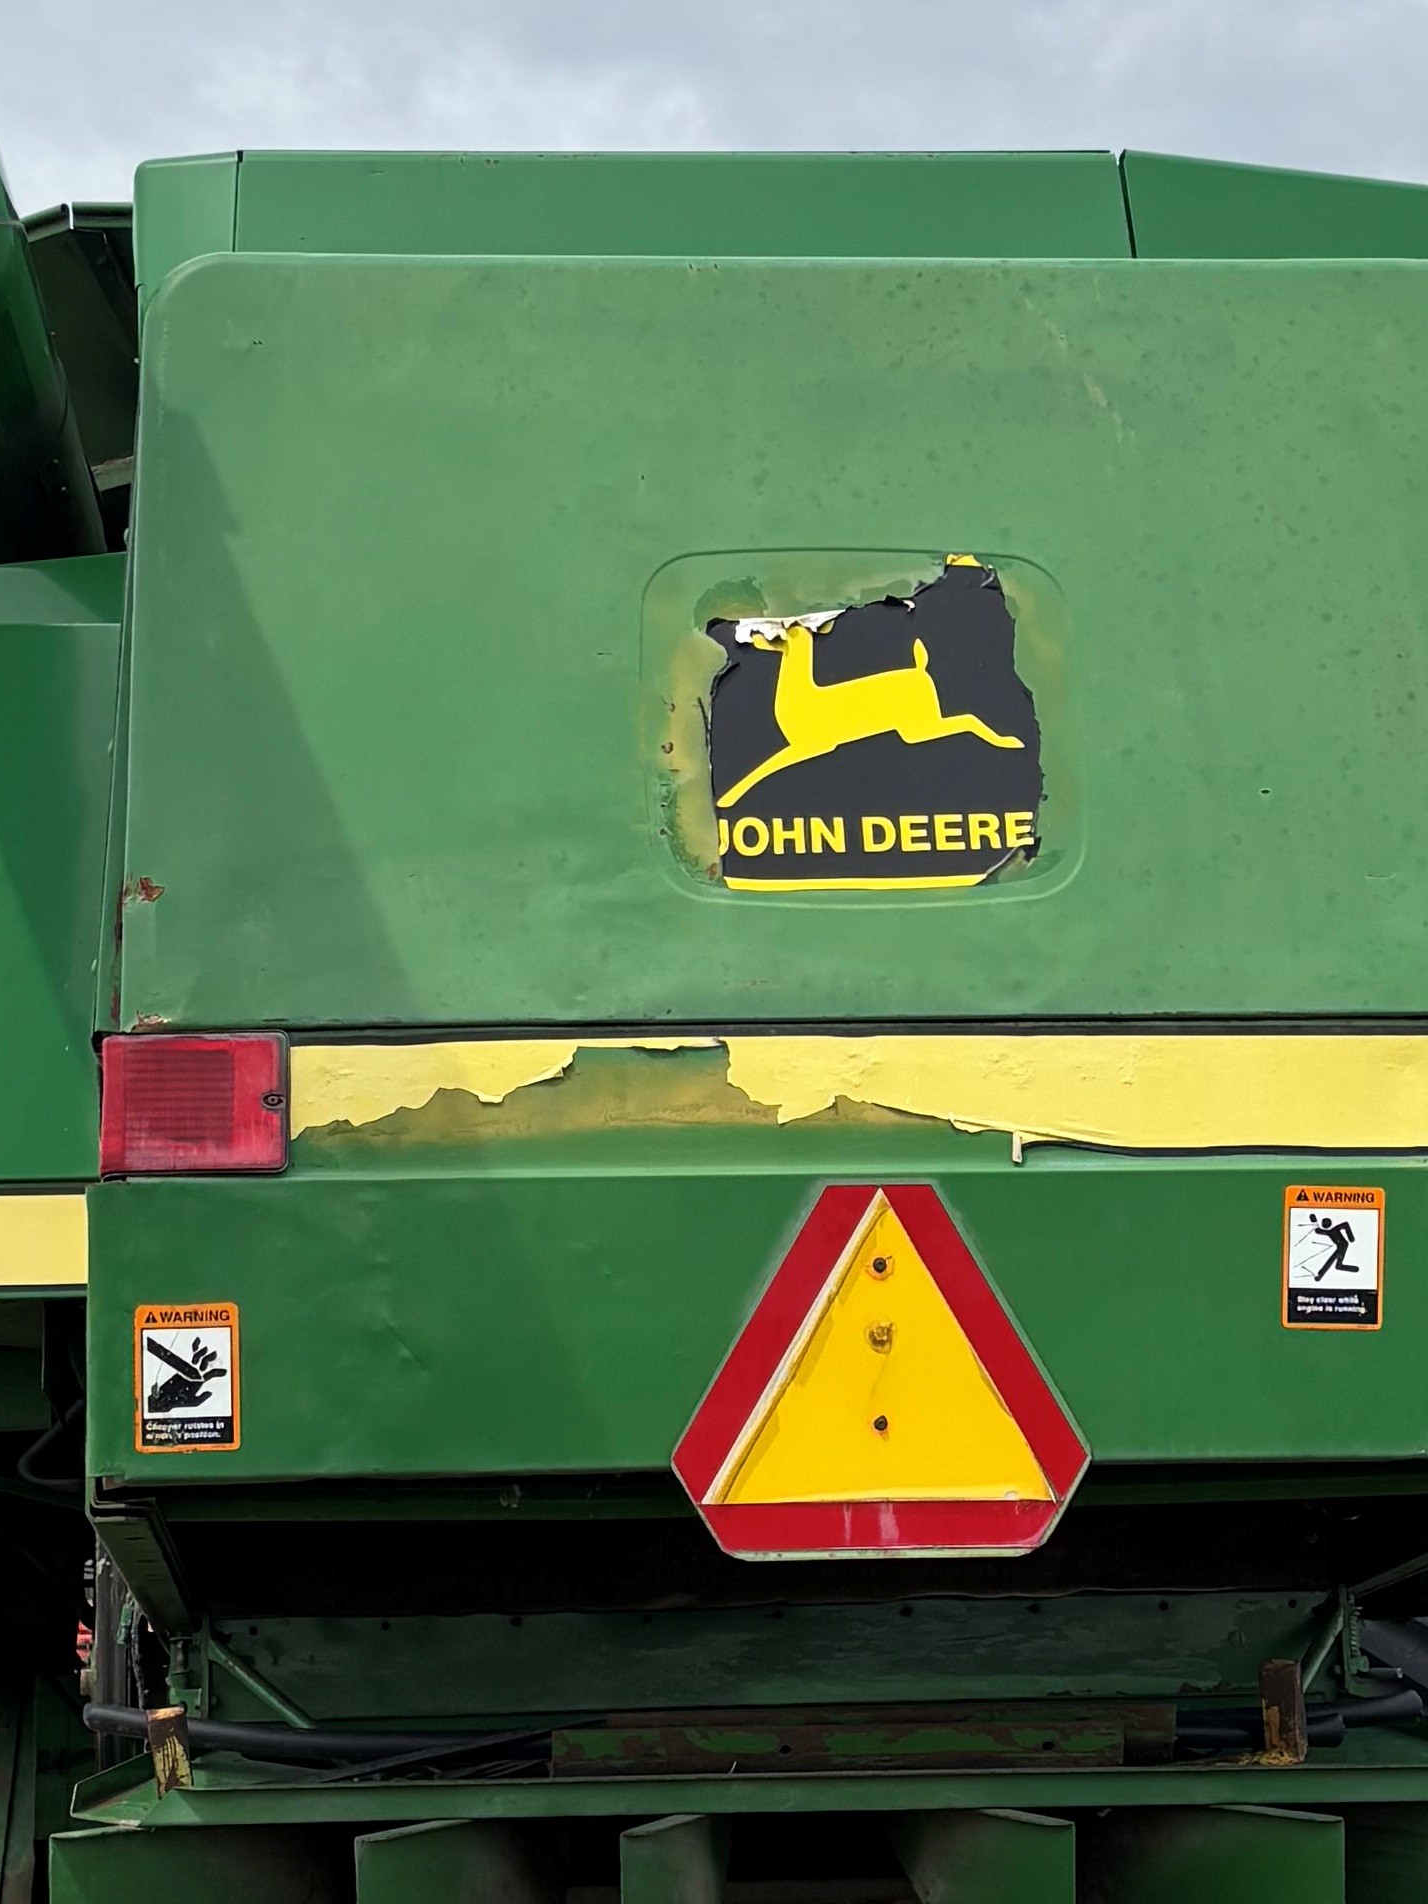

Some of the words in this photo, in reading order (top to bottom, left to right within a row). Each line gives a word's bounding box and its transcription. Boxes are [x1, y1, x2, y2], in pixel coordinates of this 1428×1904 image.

[718, 816, 846, 857] JOHN
[860, 811, 1035, 853] DEERE
[1313, 1191, 1375, 1203] WARNING
[1316, 1296, 1336, 1304] clear
[1297, 1305, 1323, 1313] engine
[159, 1309, 231, 1323] WARNING
